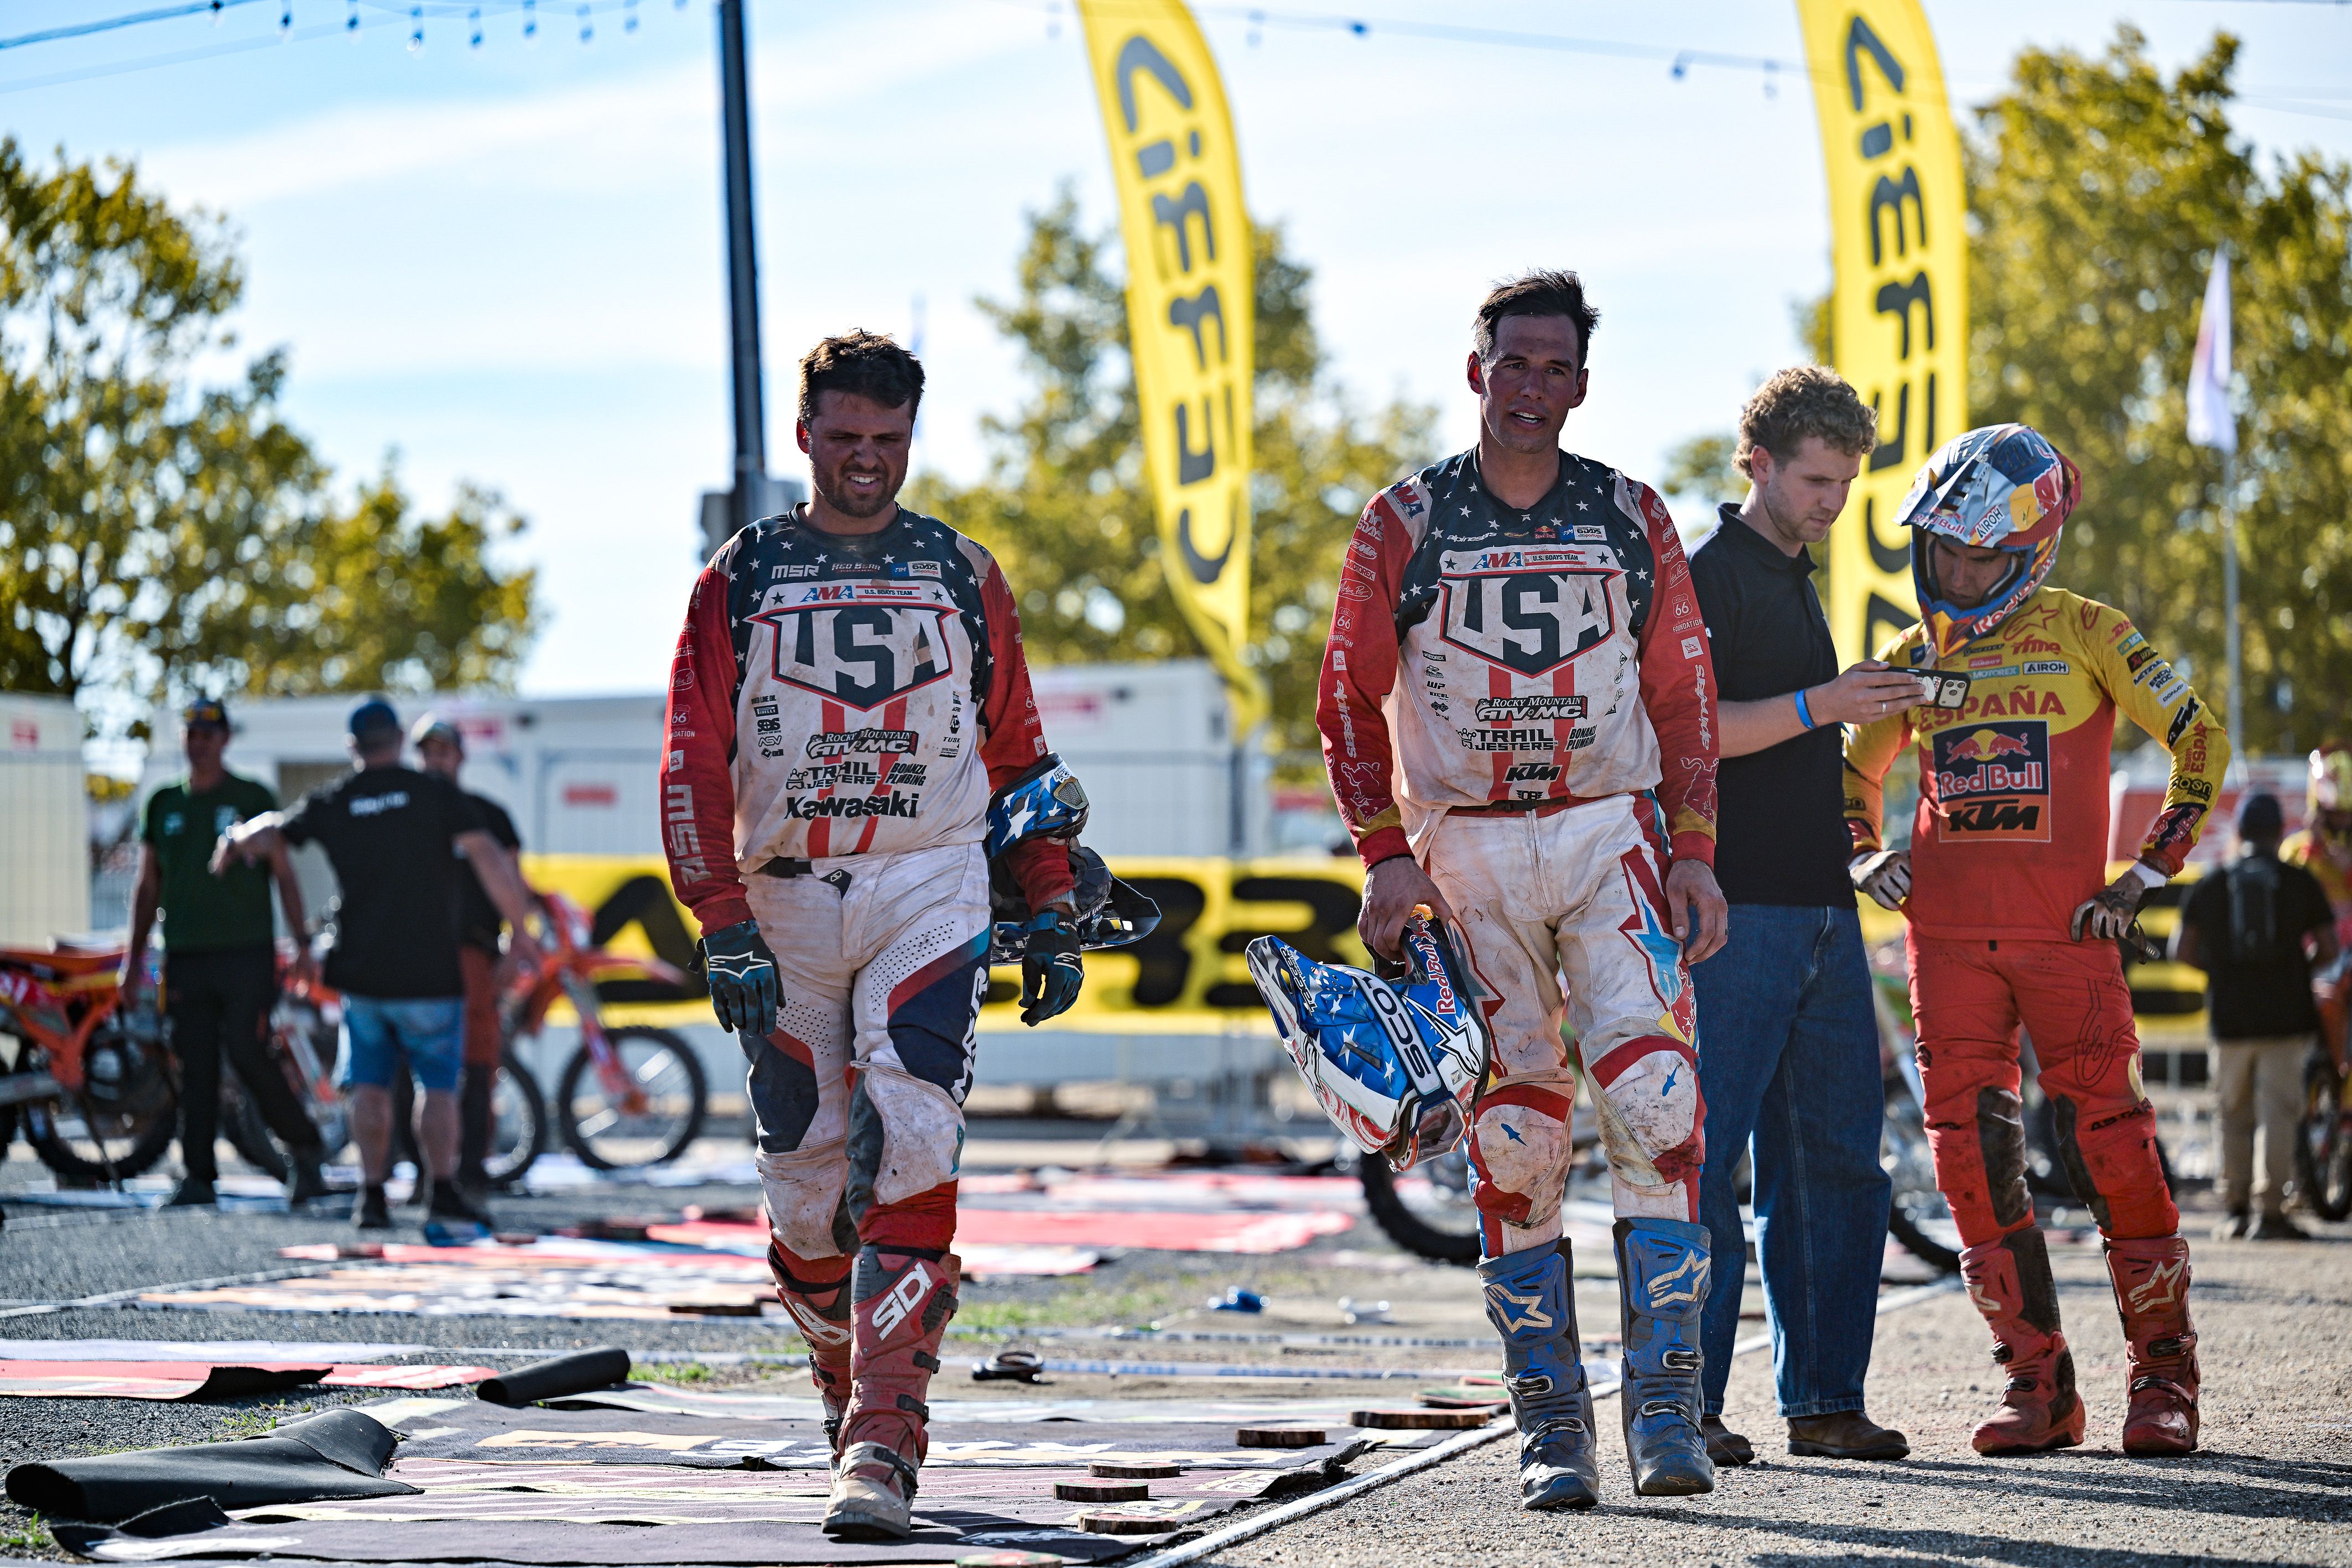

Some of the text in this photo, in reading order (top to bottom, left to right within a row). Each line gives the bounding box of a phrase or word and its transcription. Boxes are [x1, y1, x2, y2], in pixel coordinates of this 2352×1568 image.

[1939, 517, 1965, 536] Bull
[1976, 508, 2004, 538] AIROH
[1346, 560, 1375, 580] MOTOREX
[1471, 552, 1525, 570] AMA
[771, 564, 820, 579] MSR
[800, 585, 857, 603] AMA
[1442, 572, 1610, 657] USA
[1675, 602, 1689, 616] 66
[1338, 615, 1351, 629] 66
[1673, 618, 1703, 633] FOUNDATION
[770, 610, 945, 690] USA
[1971, 668, 2017, 680] MOTOREX
[2027, 663, 2067, 673] AIROH
[1427, 680, 1446, 690] WP
[757, 706, 776, 715] PIRELLI
[1492, 697, 1581, 707] ROCKY MOUNTAIN
[1917, 685, 2067, 733] ESPAÑA
[672, 712, 687, 724] 66
[1334, 679, 1357, 758] alpinestars
[1479, 706, 1581, 720] ATV MC
[758, 735, 782, 748] ASV
[825, 728, 912, 742] ROCKY MOUNTAIN
[1474, 728, 1554, 742] TRAIL
[810, 739, 910, 757] ATV MC
[1475, 742, 1554, 751] JESTERS
[806, 761, 878, 780] TRAIL
[1505, 762, 1561, 782] KTM
[1940, 762, 2042, 798] Red Bull
[783, 790, 919, 821] Kawasaki
[1949, 799, 2039, 833] KTM
[667, 784, 713, 886] MSR
[1415, 941, 1456, 1014] Red Bull
[872, 1261, 933, 1341] SIDI
